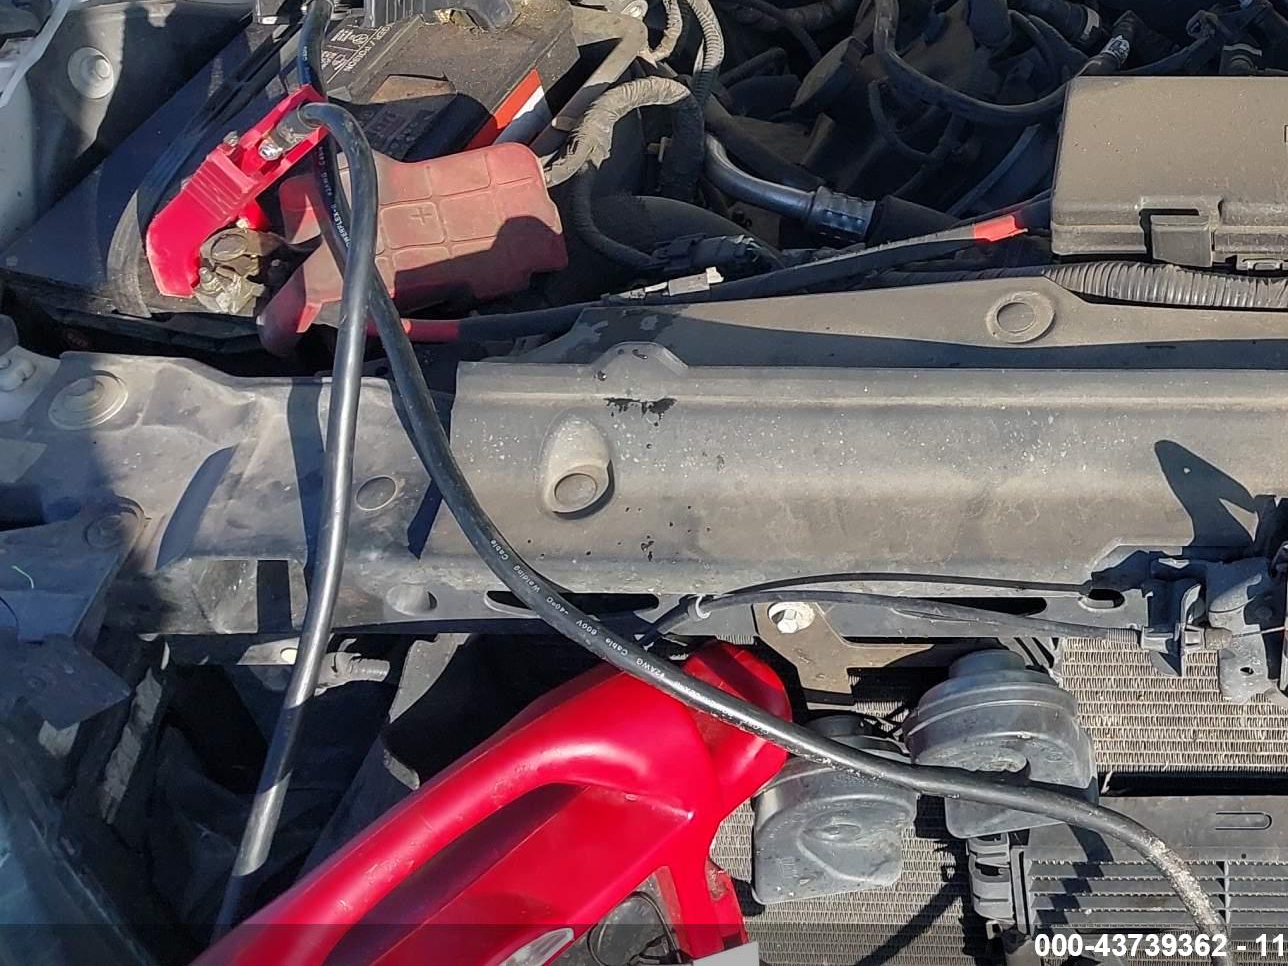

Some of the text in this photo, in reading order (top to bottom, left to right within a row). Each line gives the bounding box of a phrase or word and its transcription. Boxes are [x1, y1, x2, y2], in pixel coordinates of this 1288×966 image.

[490, 539, 509, 561] Cable
[513, 564, 540, 594] Welding
[575, 619, 598, 636] 600V
[605, 637, 629, 656] Cable
